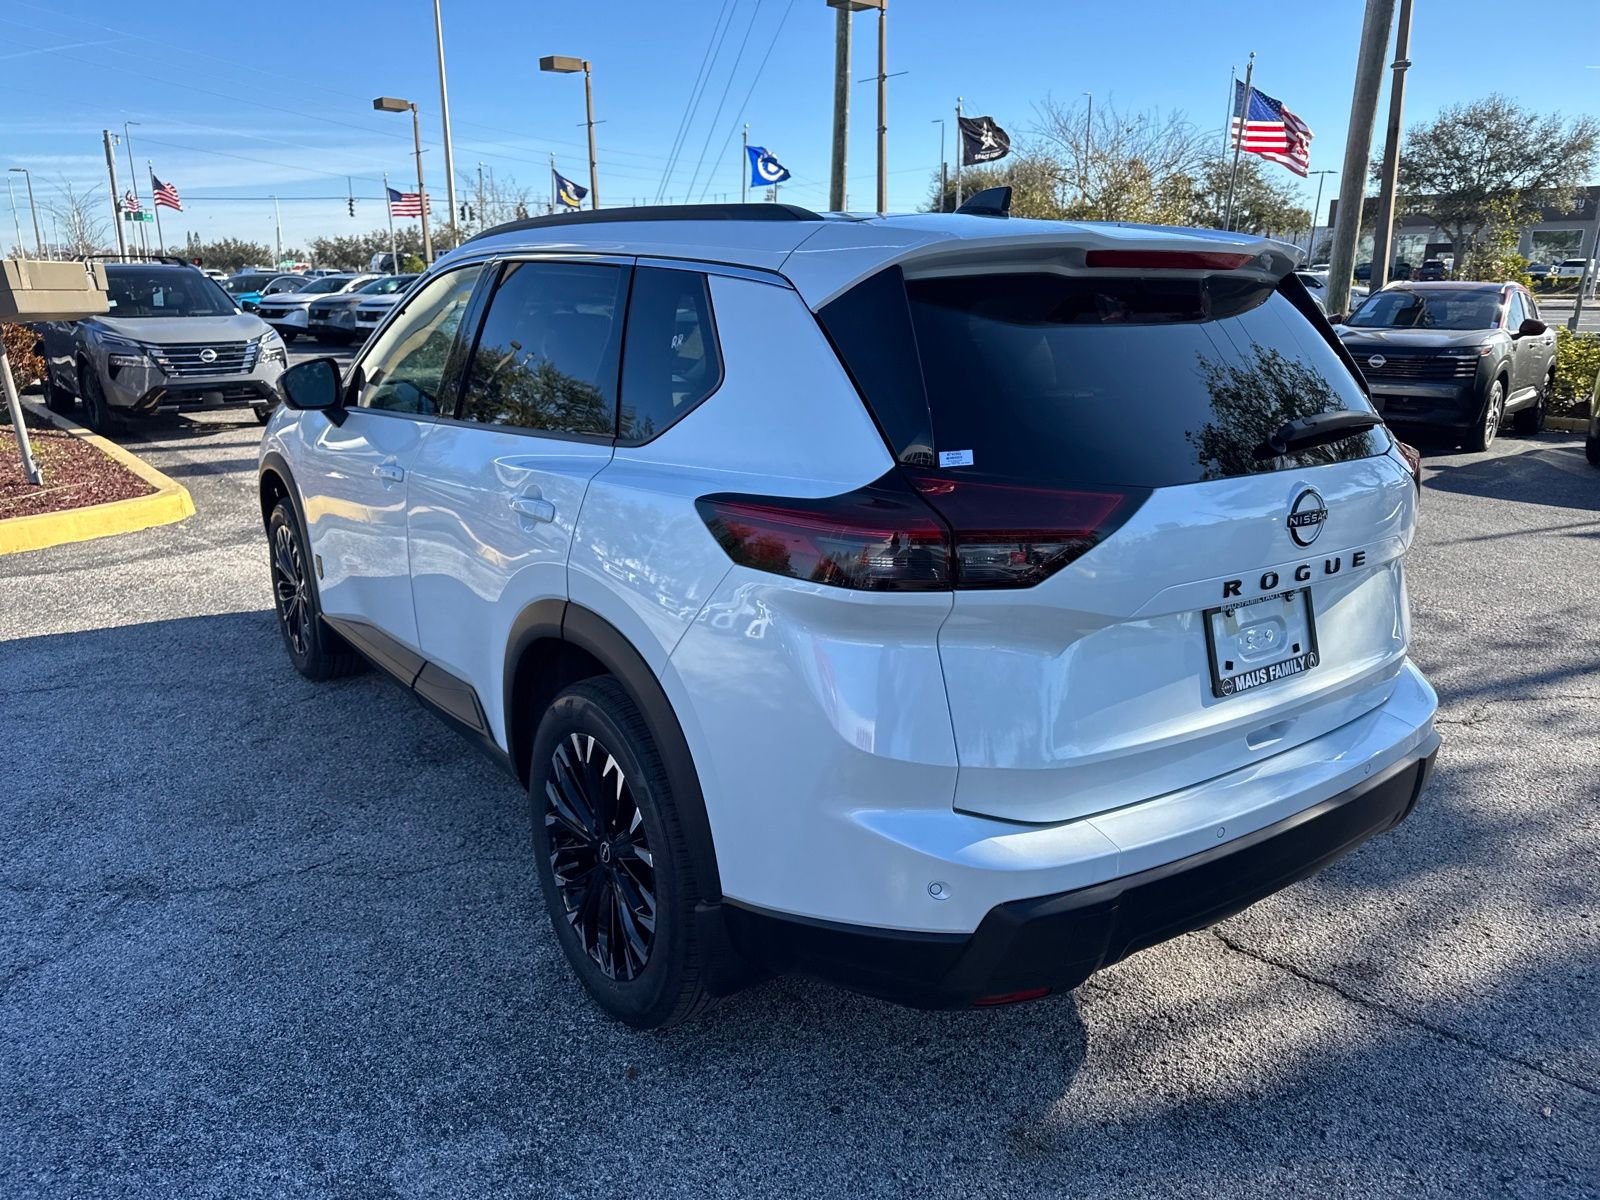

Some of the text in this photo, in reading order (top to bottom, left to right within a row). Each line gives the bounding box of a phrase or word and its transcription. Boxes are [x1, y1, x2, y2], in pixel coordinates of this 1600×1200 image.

[1290, 511, 1327, 526] NISSAN
[1222, 551, 1367, 598] ROGUE
[1234, 656, 1306, 691] MAUS FAMILY
